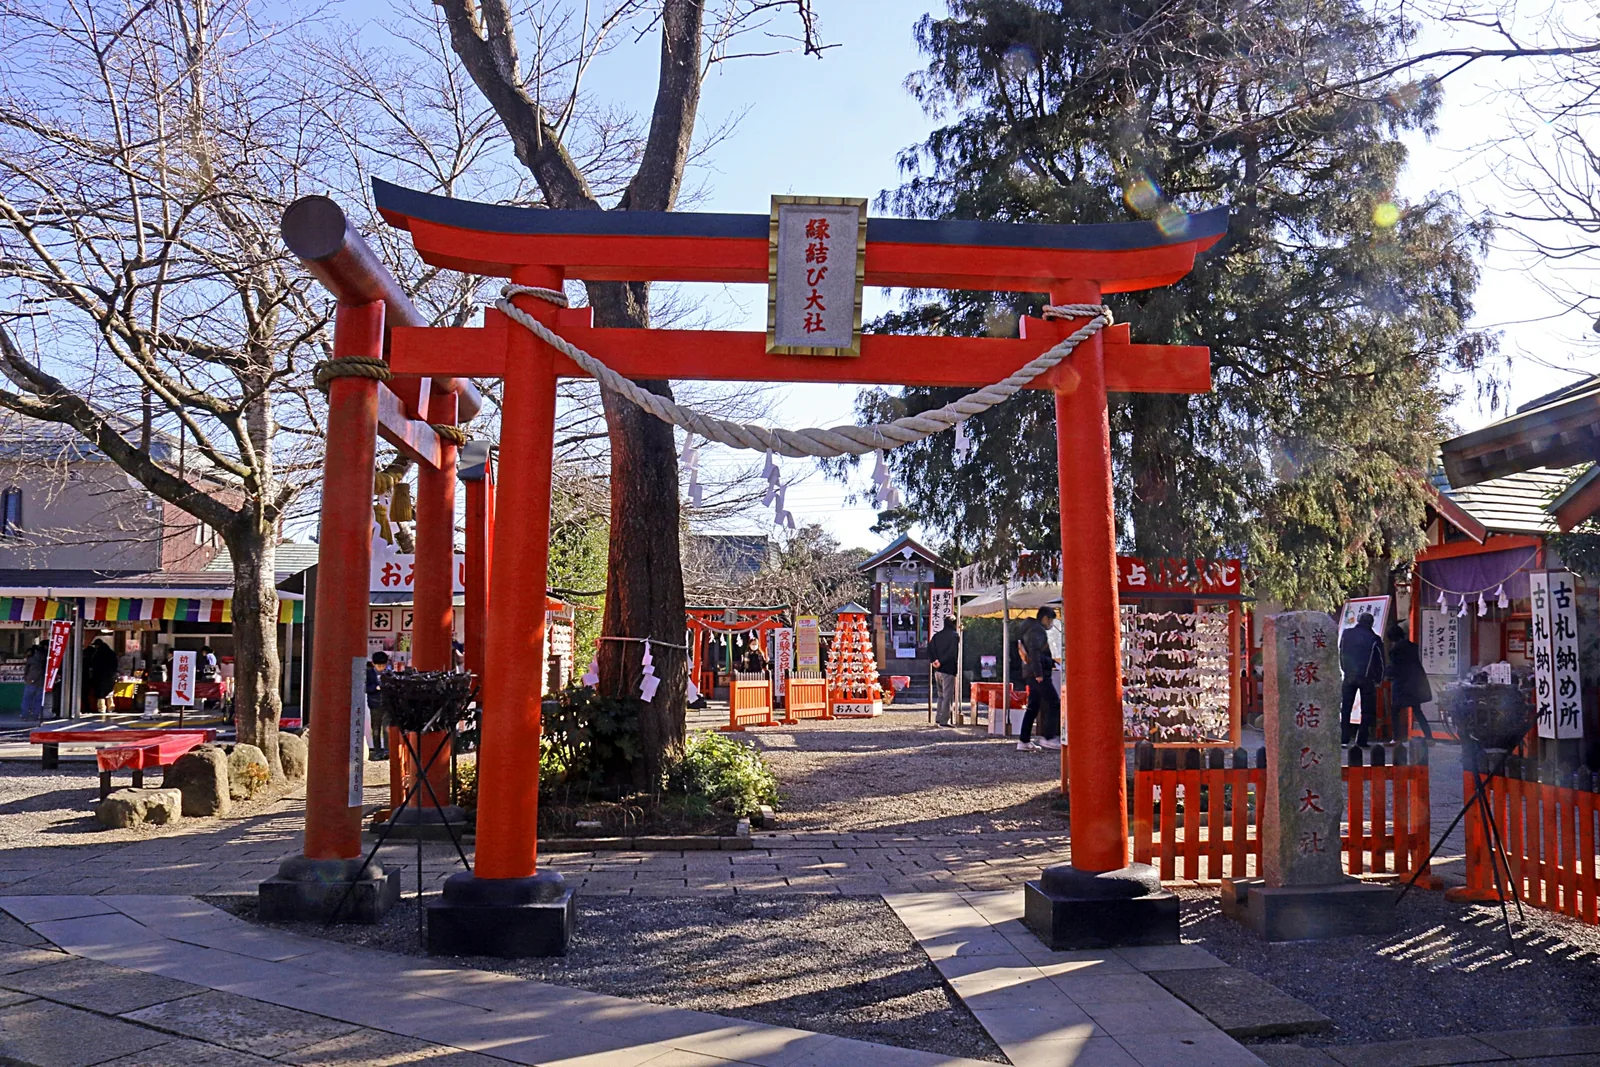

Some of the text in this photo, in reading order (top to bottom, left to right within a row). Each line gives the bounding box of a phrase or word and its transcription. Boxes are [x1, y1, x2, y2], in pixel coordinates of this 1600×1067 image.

[803, 218, 831, 334] 縁結び大社
[178, 655, 188, 690] 祈願受付
[1286, 630, 1328, 648] 千葉
[1533, 582, 1552, 730] 古札納め所
[1553, 581, 1580, 730] 古札納め所
[836, 704, 870, 713] おみくじ
[1293, 660, 1325, 854] 縁結び大社
